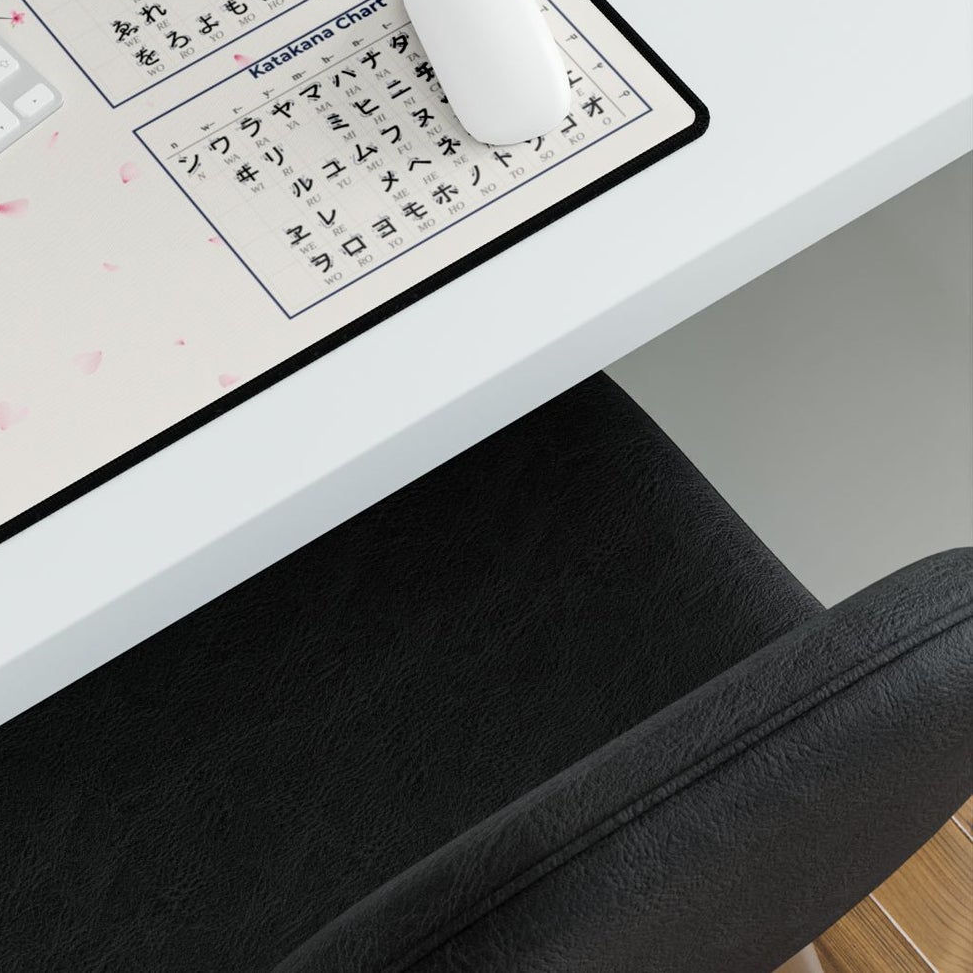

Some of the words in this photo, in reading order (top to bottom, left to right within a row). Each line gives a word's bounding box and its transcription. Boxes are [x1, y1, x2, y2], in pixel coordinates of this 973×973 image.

[135, 49, 160, 66] を
[166, 31, 190, 49] ろ
[199, 16, 219, 35] よ
[224, 0, 248, 15] も
[141, 5, 167, 23] れ
[248, 28, 335, 79] Katakana
[178, 154, 199, 174] ン
[210, 136, 230, 155] ワ
[240, 117, 260, 138] ラ
[272, 101, 292, 119] ヤ
[298, 83, 322, 99] マ
[332, 70, 357, 88] ハ
[361, 51, 381, 70] ナ
[389, 34, 410, 55] タ
[264, 146, 284, 166] リ
[327, 113, 350, 131] ミ
[352, 98, 380, 116] ヒ
[387, 79, 412, 100] ニ
[293, 178, 313, 198] ル
[322, 160, 347, 179] ユ
[355, 144, 378, 162] ム
[380, 124, 401, 144] フ
[411, 107, 435, 128] ヌ
[311, 253, 331, 273] ヲ
[341, 236, 367, 257] ロ
[372, 218, 397, 239] ヨ
[402, 202, 428, 218] モ
[432, 184, 458, 205] ホ
[493, 151, 512, 168] ト
[582, 97, 604, 117] オ
[317, 209, 336, 226] レ
[381, 170, 399, 193] メ
[437, 135, 461, 156] ネ
